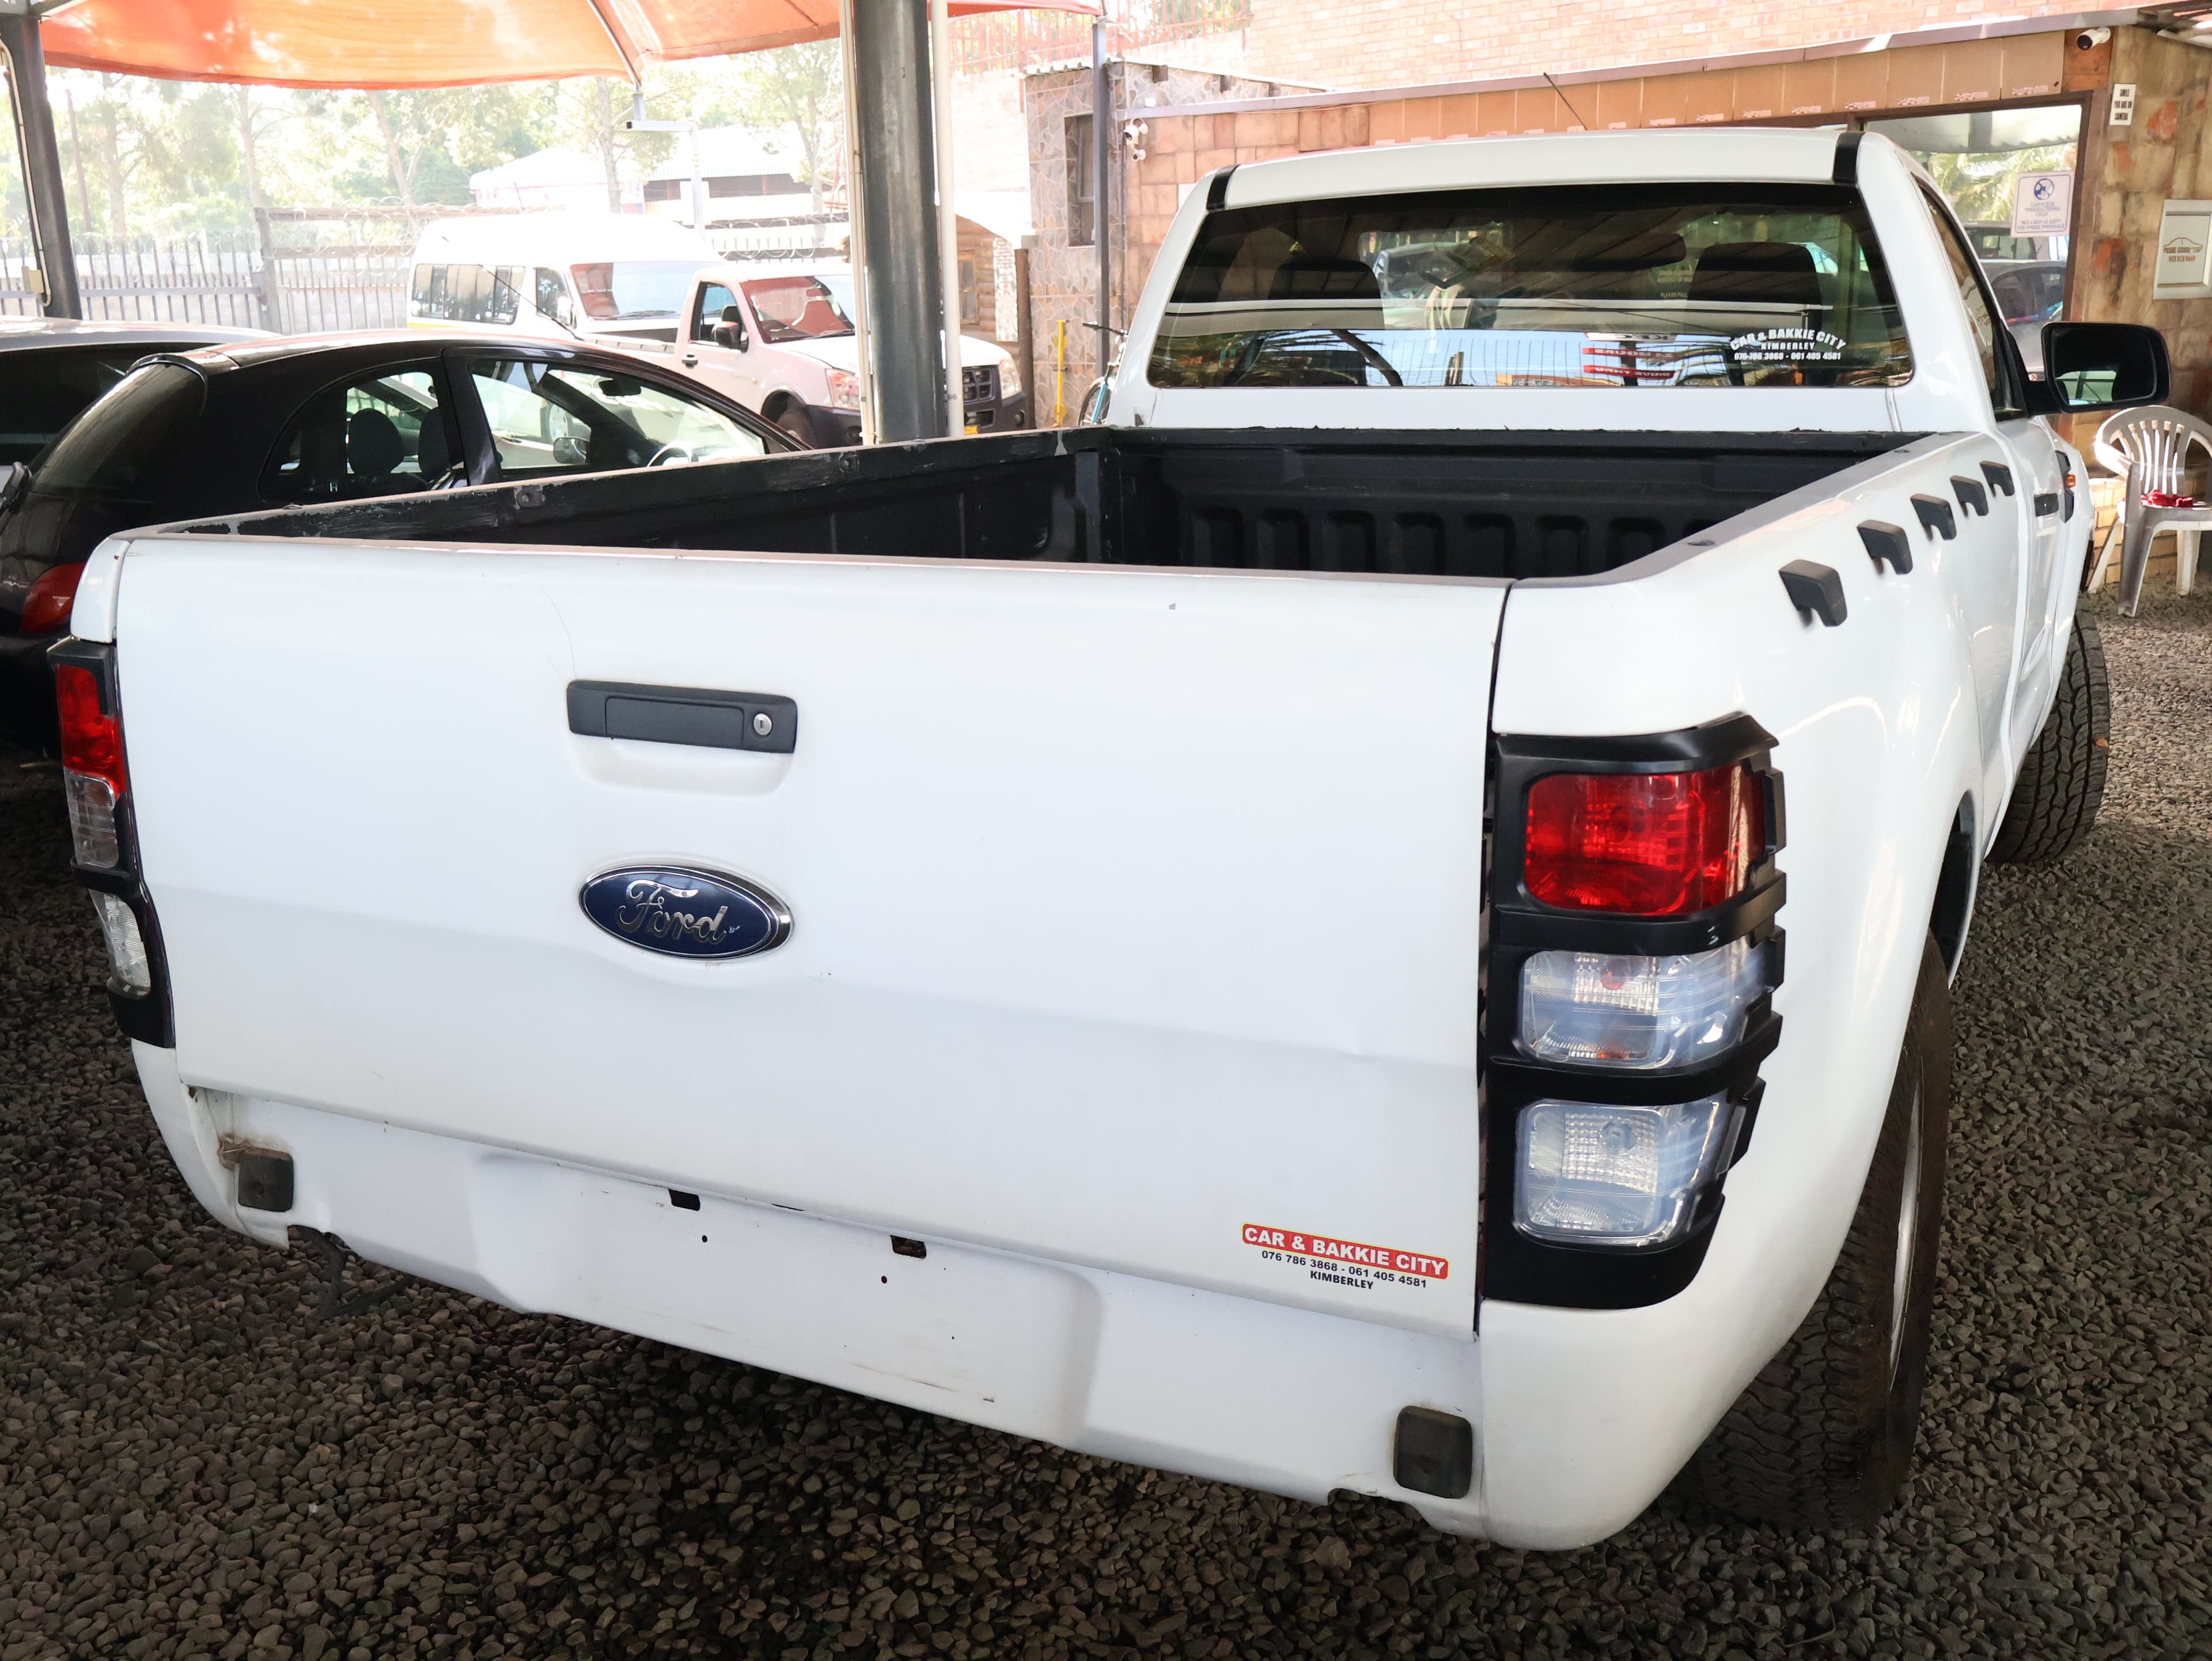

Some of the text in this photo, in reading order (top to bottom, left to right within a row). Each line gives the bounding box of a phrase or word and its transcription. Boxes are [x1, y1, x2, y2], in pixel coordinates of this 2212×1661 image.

[1730, 328, 1846, 350] CAR & BAKKIE CITY
[1761, 342, 1815, 350] KIMBERLEY
[617, 879, 729, 944] Ford
[1244, 1228, 1445, 1276] CAR & BAKKIE CITY
[1262, 1250, 1282, 1261] 076
[1286, 1255, 1306, 1265] 786
[1310, 1259, 1338, 1272] 3868
[1349, 1266, 1368, 1277] 061
[1374, 1271, 1395, 1281] 405
[1399, 1276, 1426, 1288] 4581
[1310, 1270, 1373, 1289] KIMBERLEY
